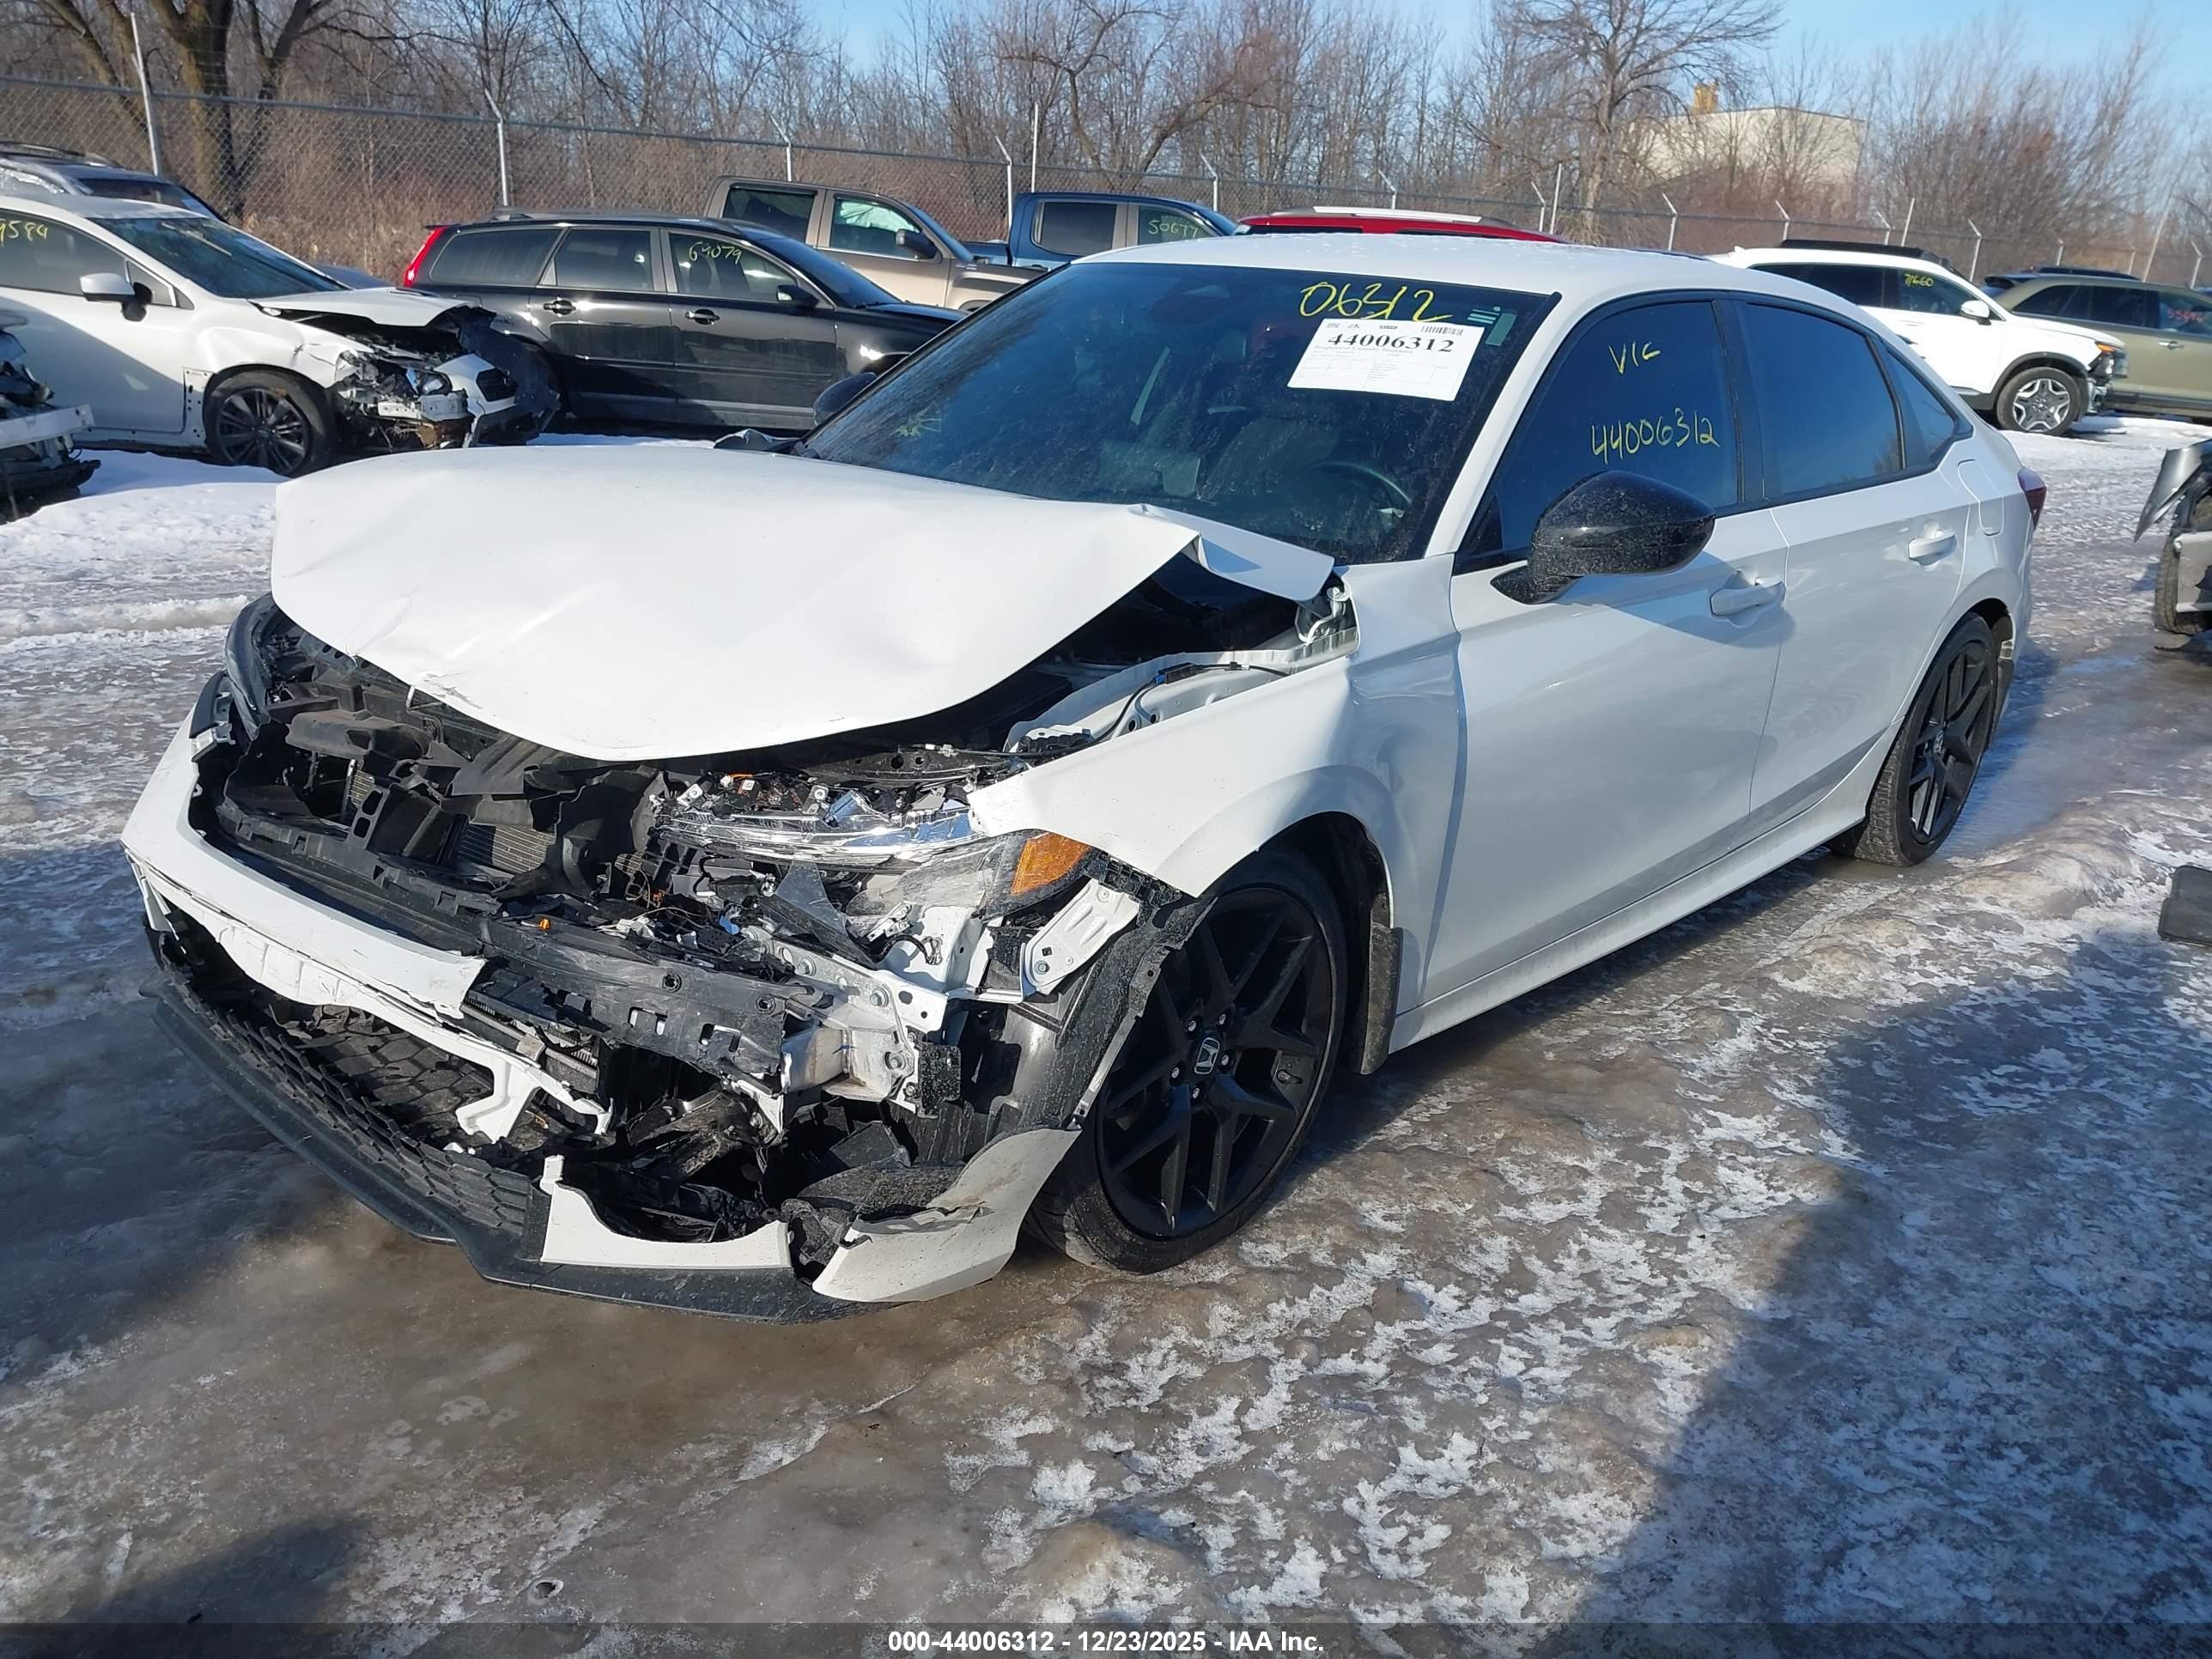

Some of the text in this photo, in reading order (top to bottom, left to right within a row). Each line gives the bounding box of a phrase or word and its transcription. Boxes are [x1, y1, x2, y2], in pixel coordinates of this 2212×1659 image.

[1299, 281, 1454, 322] 06312
[1328, 332, 1455, 353] 44006312
[1590, 407, 1722, 465] 44006312
